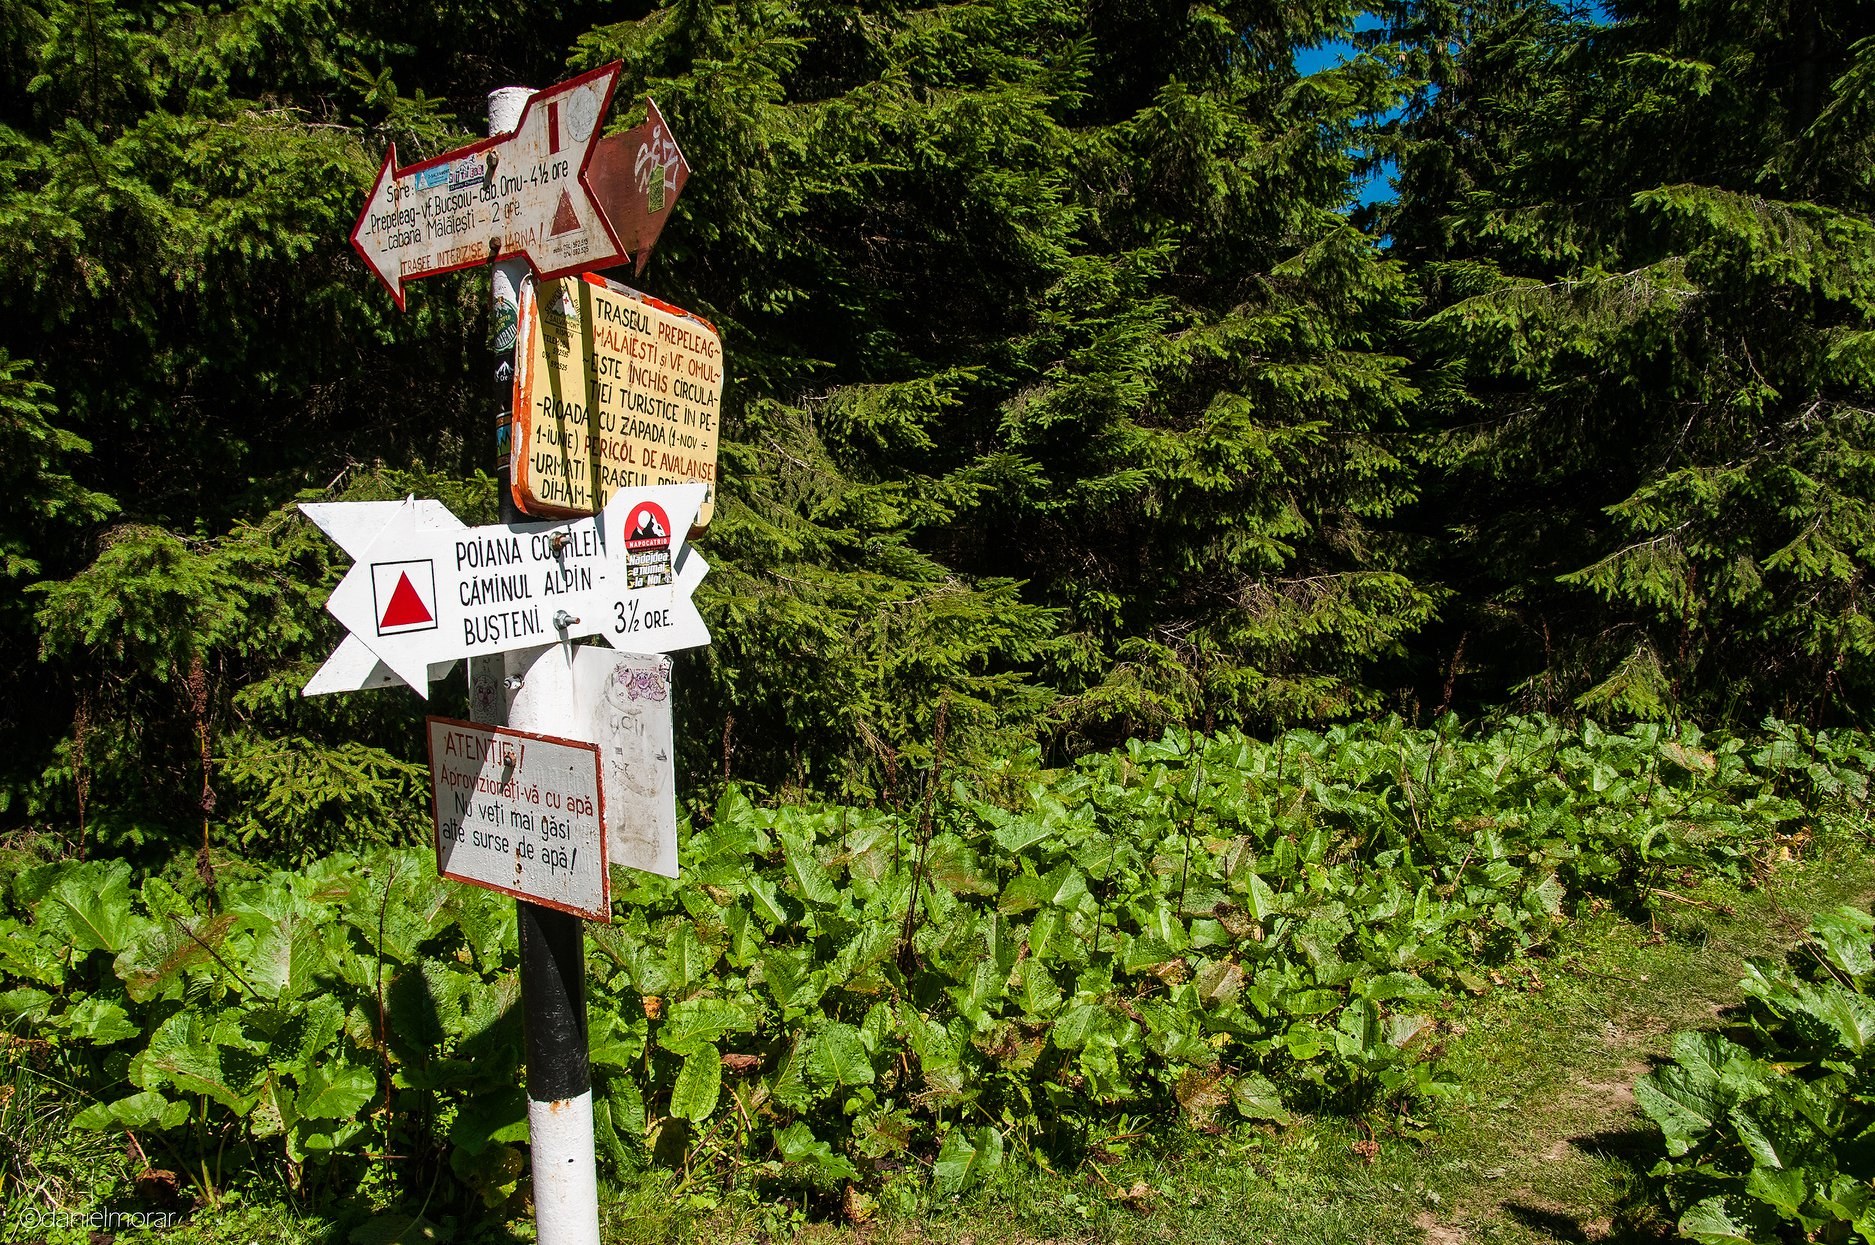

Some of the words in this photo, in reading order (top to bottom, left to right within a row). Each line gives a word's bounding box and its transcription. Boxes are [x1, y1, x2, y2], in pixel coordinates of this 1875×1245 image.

[550, 160, 569, 180] ore
[491, 202, 500, 225] 2
[436, 241, 484, 266] INTERZISE
[595, 297, 652, 336] TRASEUL
[619, 386, 679, 423] TURISTICE
[598, 410, 616, 433] CU
[642, 447, 658, 470] DE
[544, 564, 593, 597] ALPIN
[644, 609, 674, 629] ORE.
[454, 791, 473, 818] Nu
[478, 801, 504, 827] veți
[510, 810, 534, 832] mai
[540, 815, 571, 842] găsi
[545, 791, 561, 810] cu
[566, 794, 593, 818] apă
[442, 818, 466, 844] alte
[472, 829, 510, 854] surse
[518, 835, 535, 860] de
[541, 847, 578, 876] apă!
